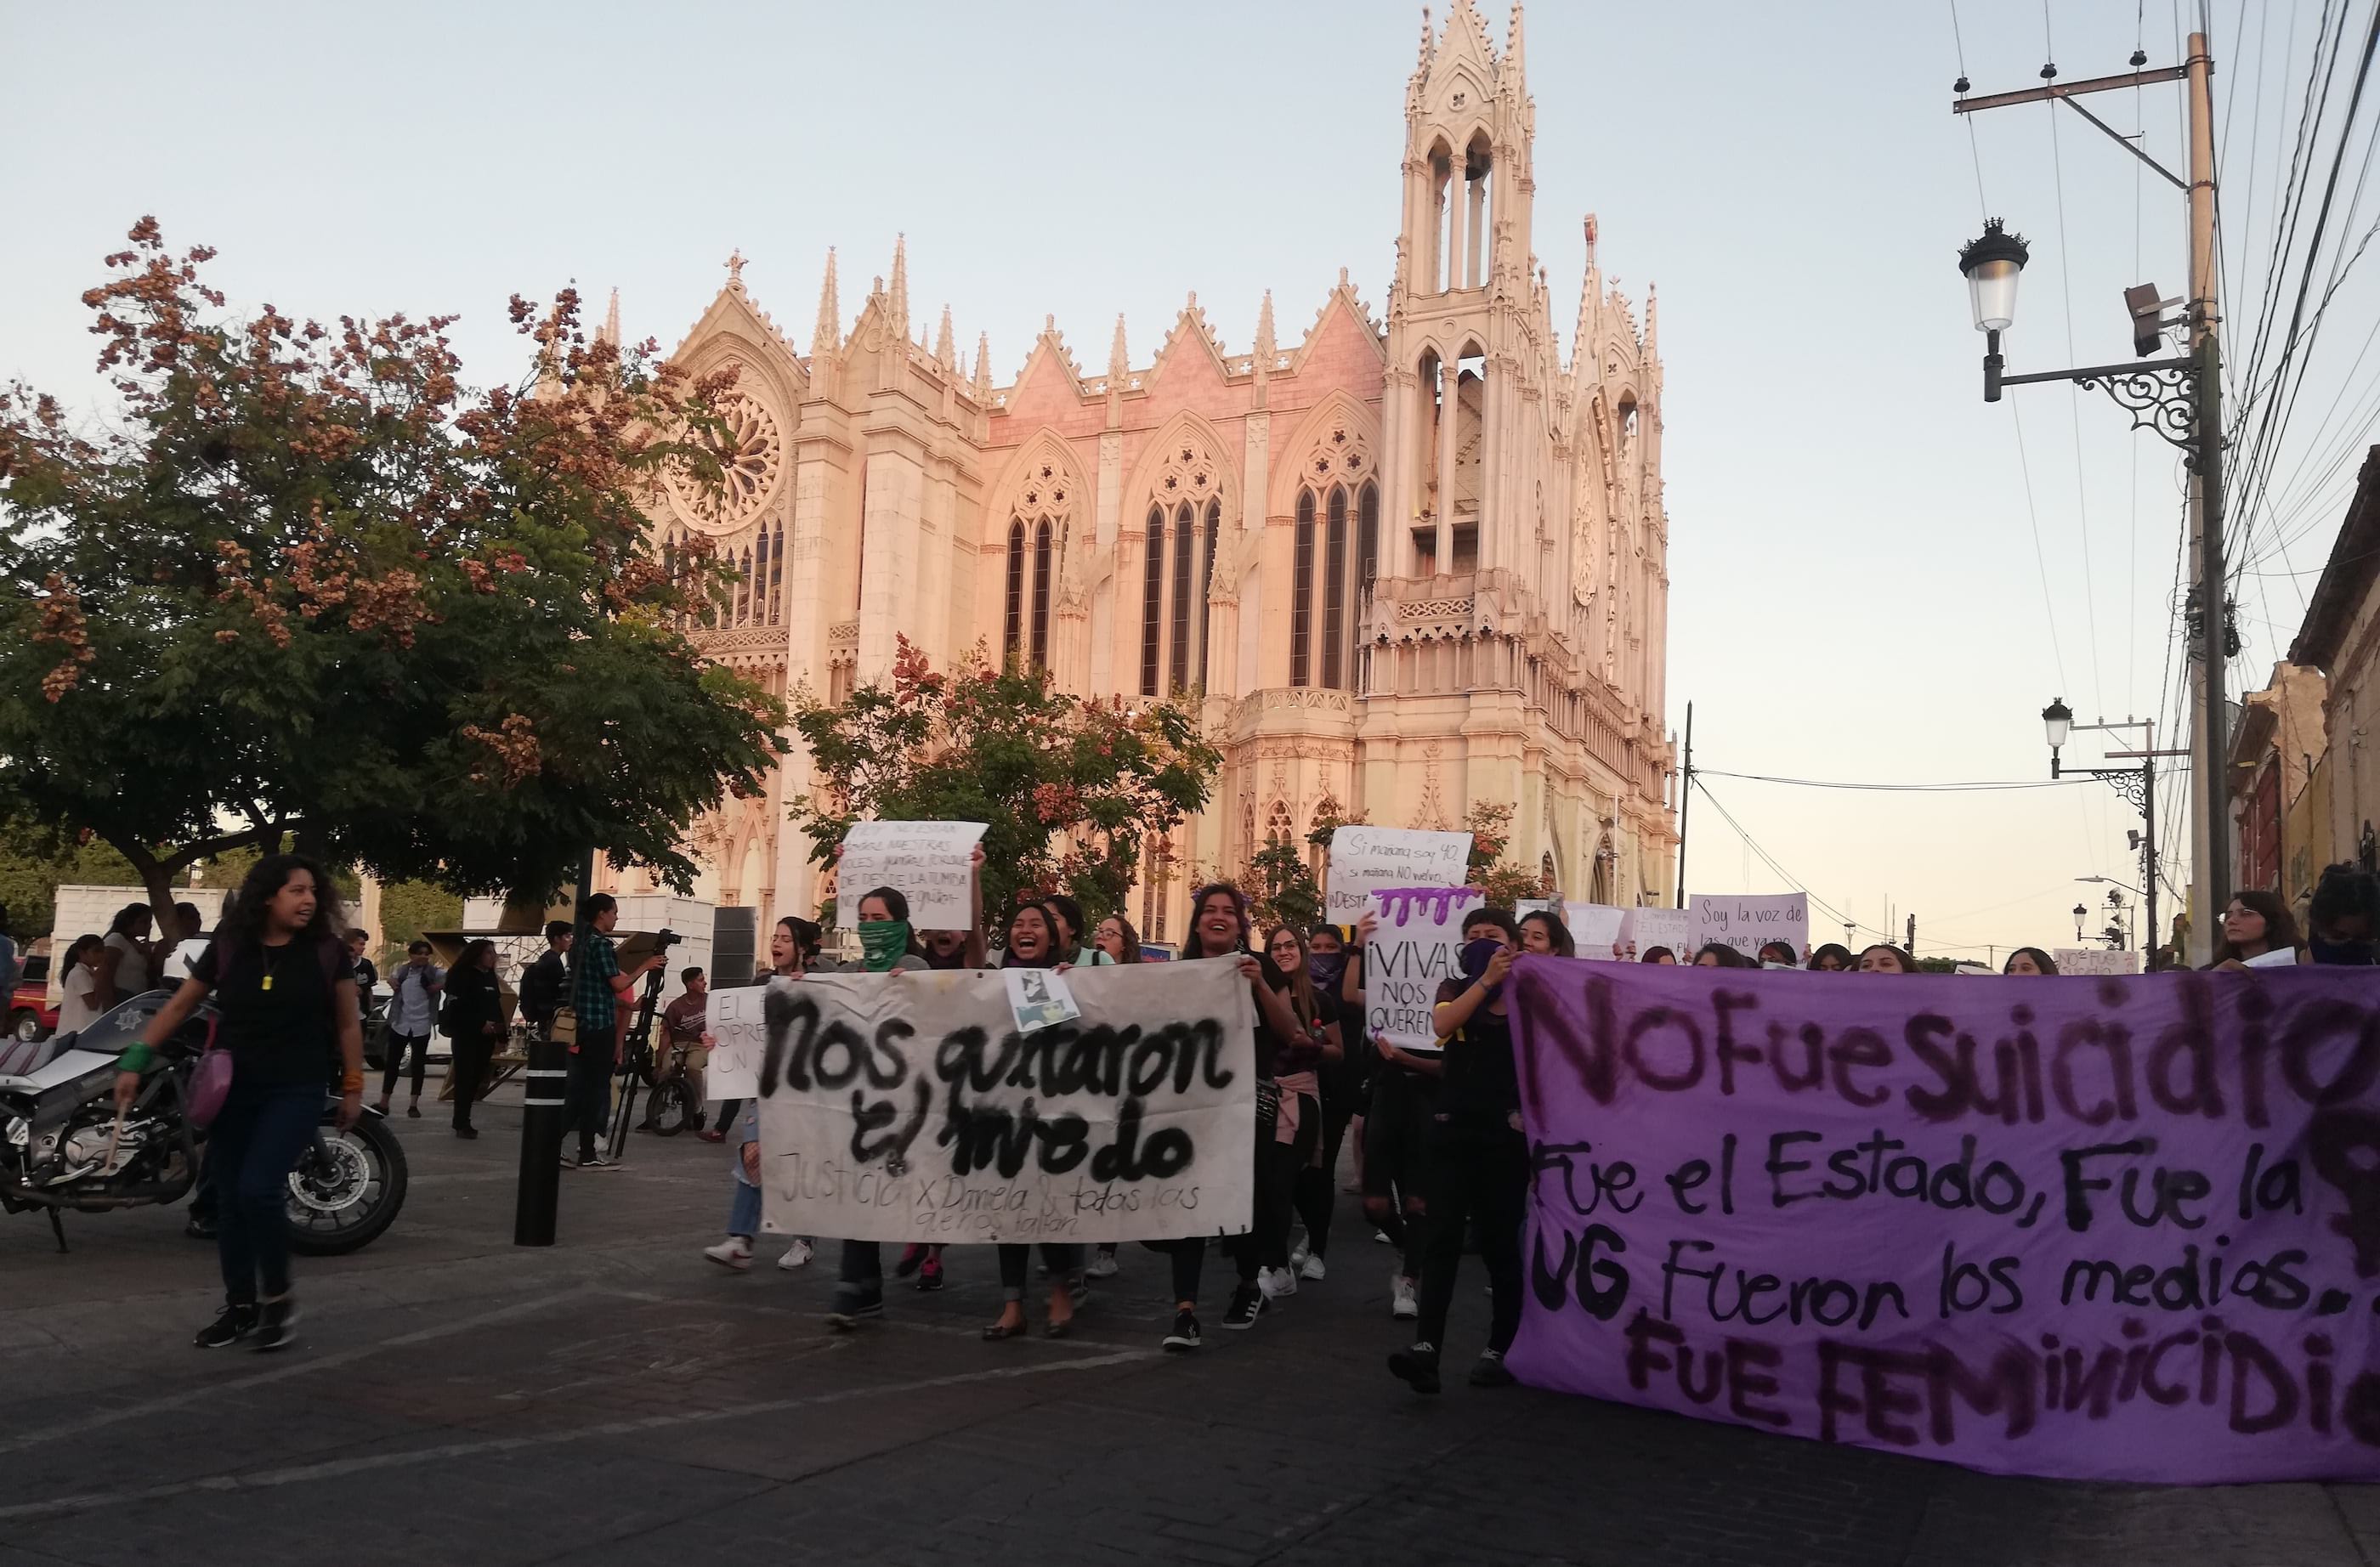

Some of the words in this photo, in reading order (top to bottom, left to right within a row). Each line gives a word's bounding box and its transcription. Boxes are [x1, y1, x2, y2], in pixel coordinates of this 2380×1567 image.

[1414, 850, 1436, 864] soy
[1397, 865, 1412, 880] NO
[1702, 899, 1728, 931] Soy
[1738, 902, 1750, 923] la
[1755, 909, 1780, 923] voz
[1786, 905, 1802, 923] de
[1382, 981, 1426, 1005] NOS
[713, 1022, 766, 1047] OPRE
[717, 1050, 746, 1073] UN
[1069, 1175, 1141, 1217] todas
[1151, 1184, 1200, 1210] las
[1533, 1138, 1644, 1216] Fue
[1664, 1132, 1737, 1215] el
[2060, 1136, 2211, 1232] Fue
[2237, 1143, 2303, 1219] la
[1662, 1240, 1909, 1331] Fueron
[1940, 1241, 2023, 1318] los
[1624, 1309, 1791, 1428] FUE
